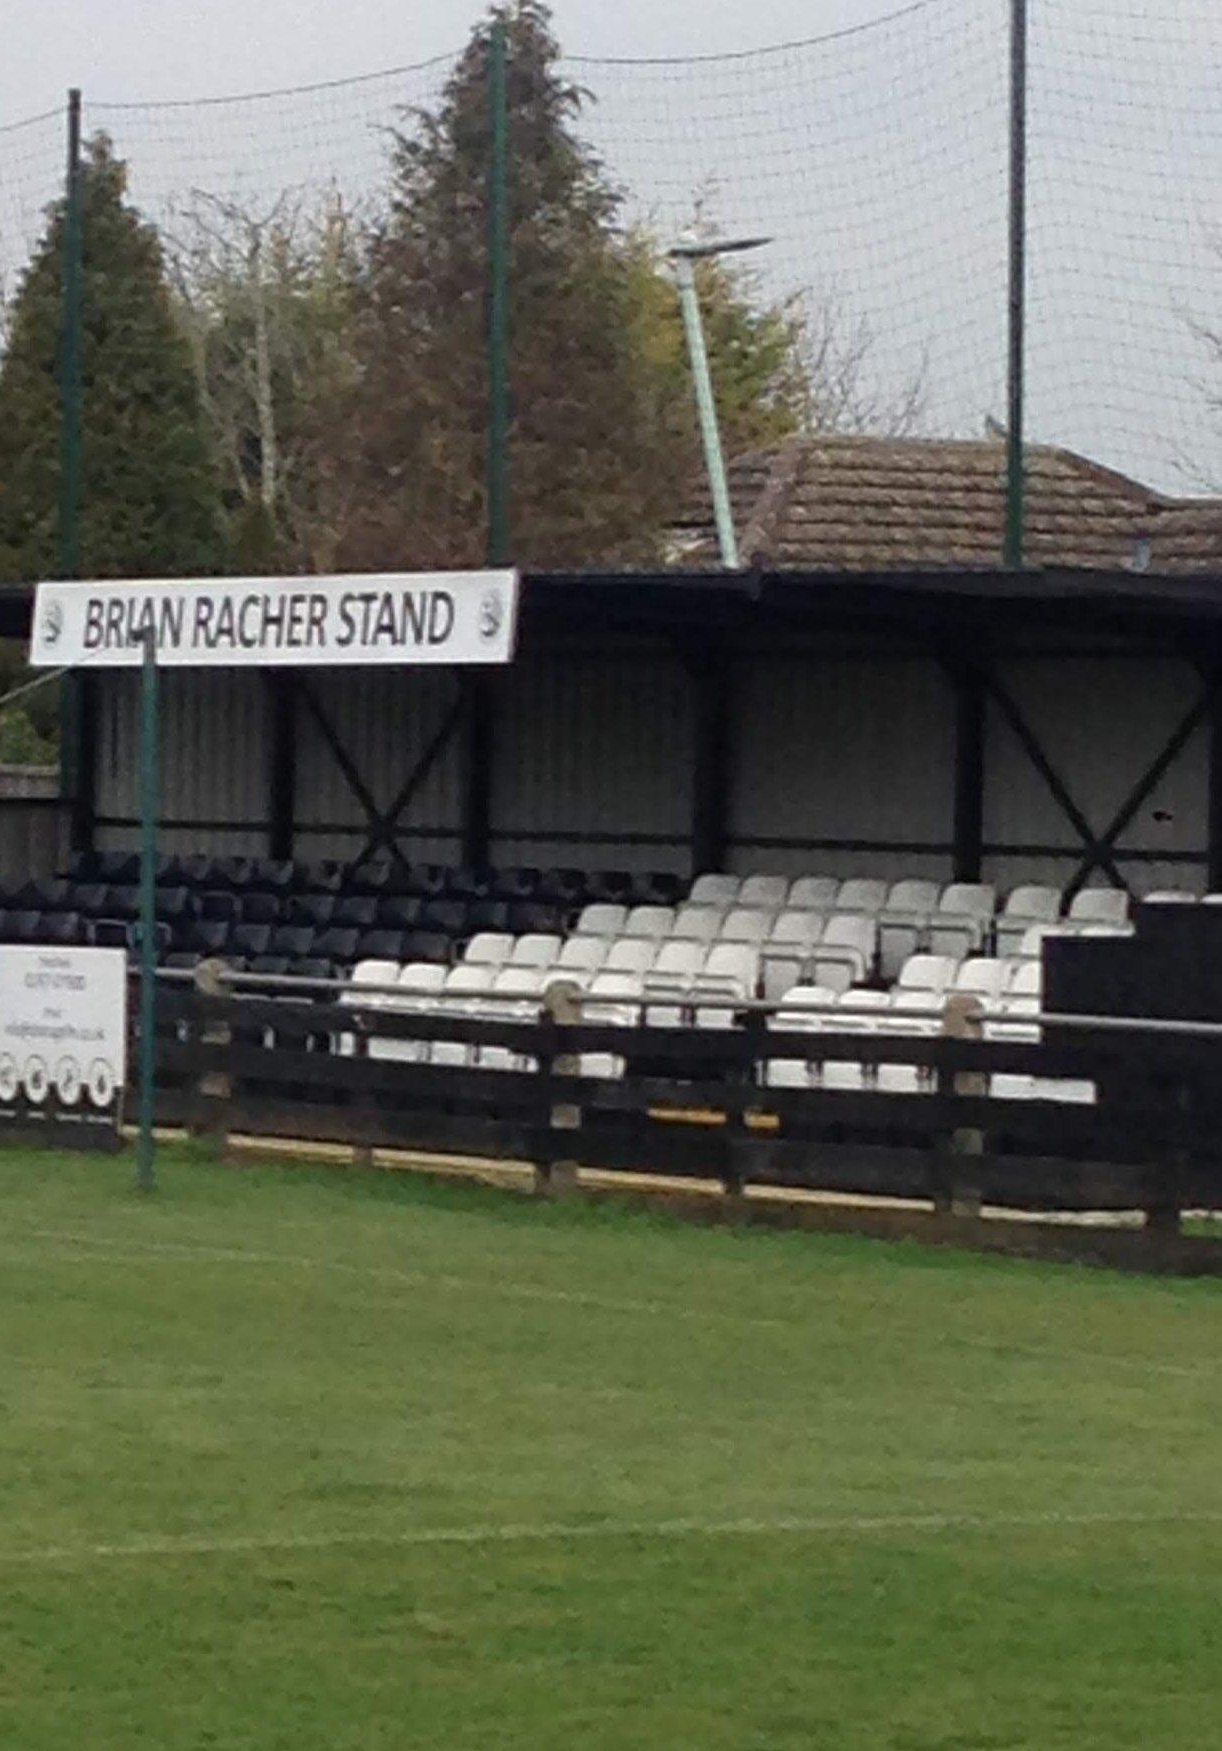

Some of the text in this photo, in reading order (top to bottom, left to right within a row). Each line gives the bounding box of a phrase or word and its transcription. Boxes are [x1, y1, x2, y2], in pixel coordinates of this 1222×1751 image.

[83, 590, 455, 649] BRIAN RACHER STAND
